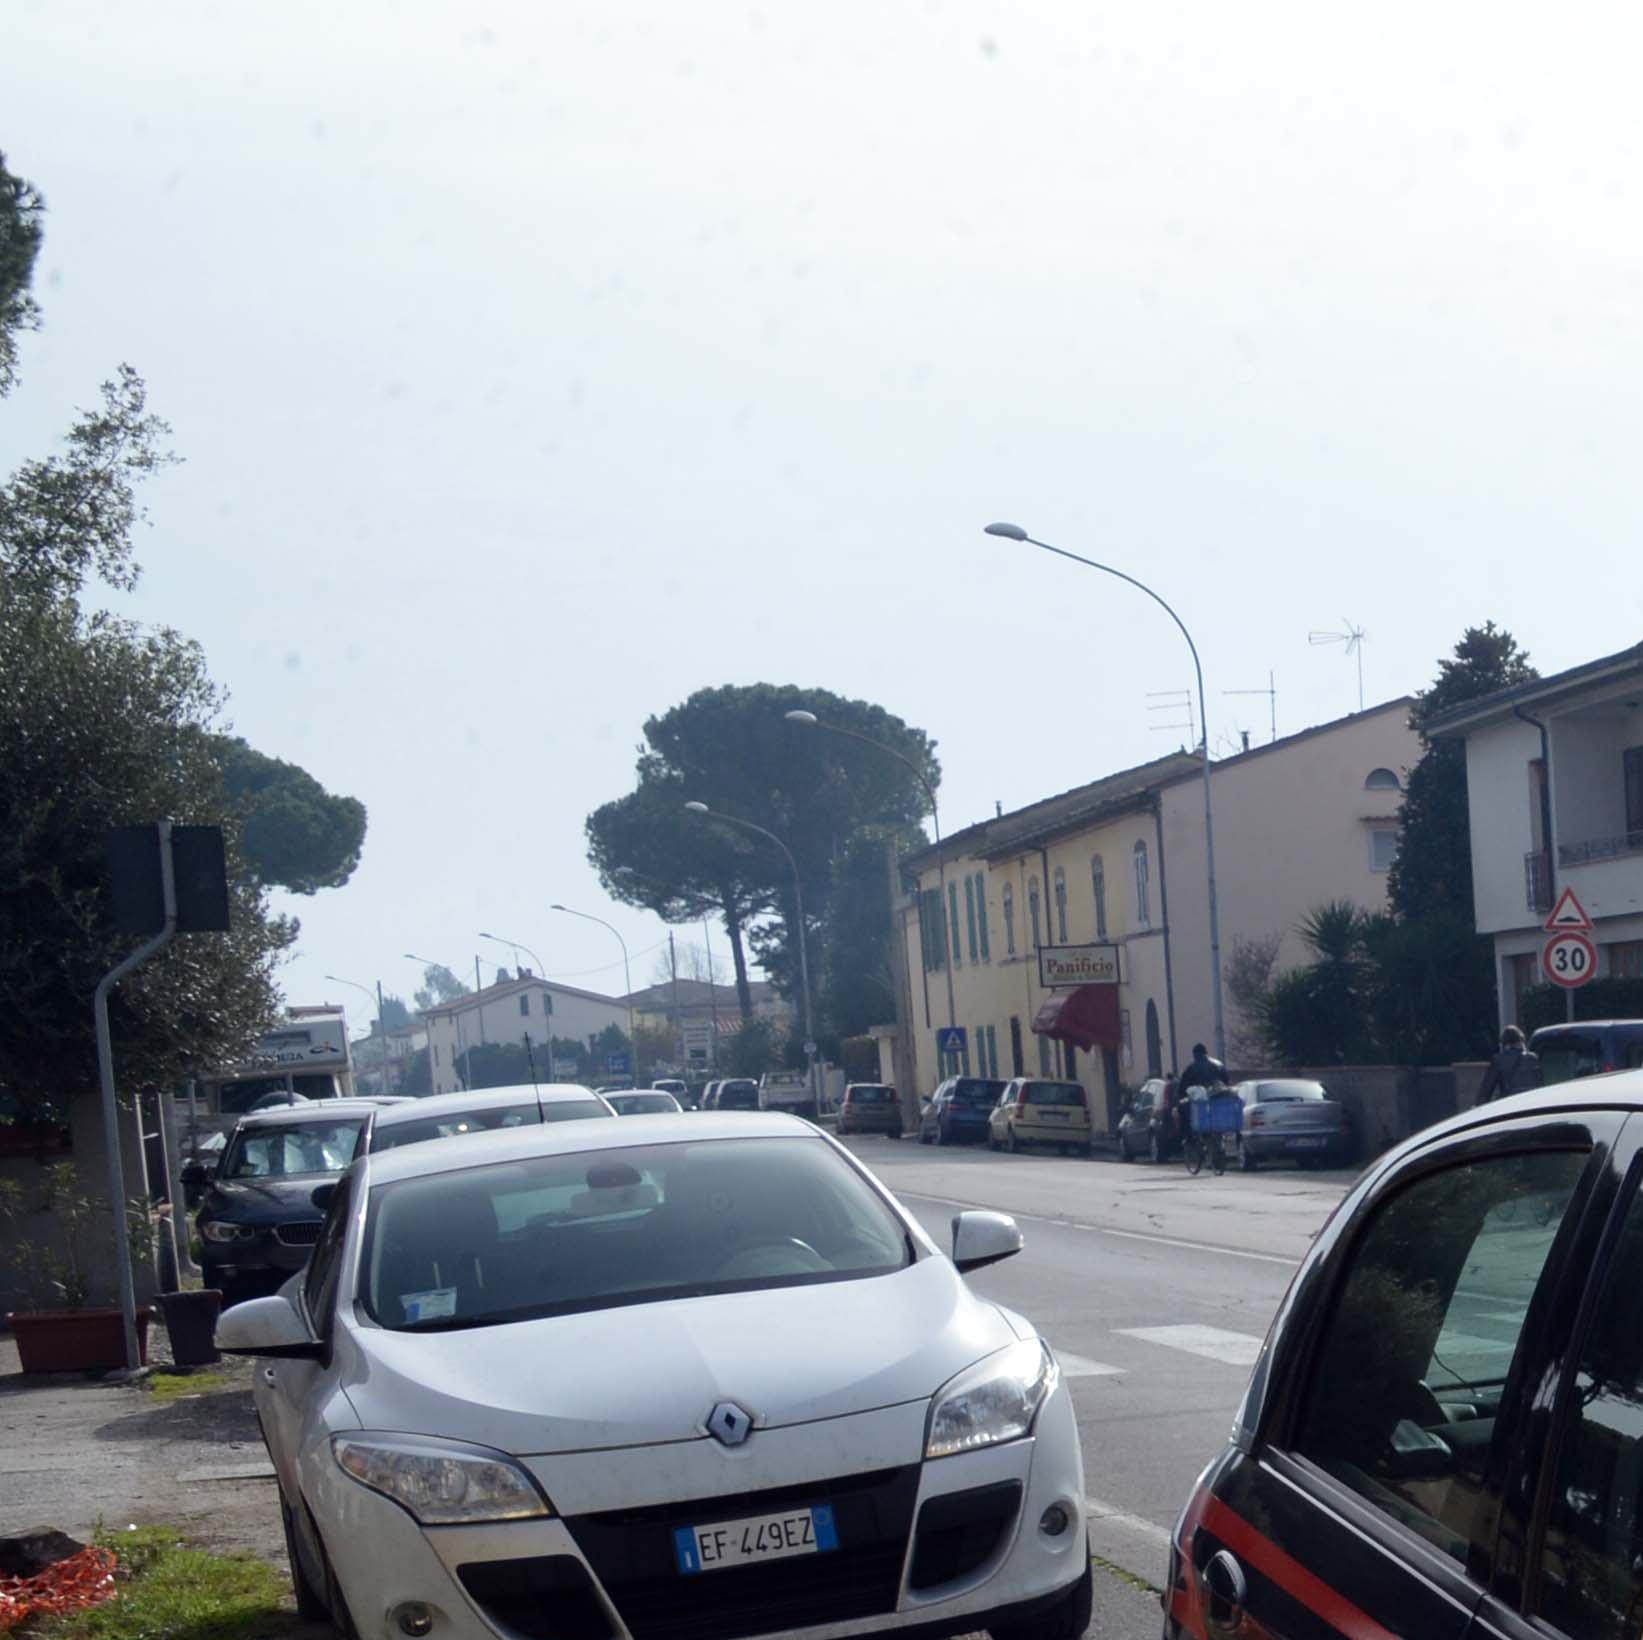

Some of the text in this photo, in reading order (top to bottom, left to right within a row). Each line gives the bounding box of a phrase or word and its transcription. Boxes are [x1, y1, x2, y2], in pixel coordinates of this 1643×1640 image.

[1047, 957, 1114, 975] Panificio
[1555, 947, 1585, 972] 30
[698, 1531, 728, 1562] EF
[740, 1516, 816, 1556] 449EZ
